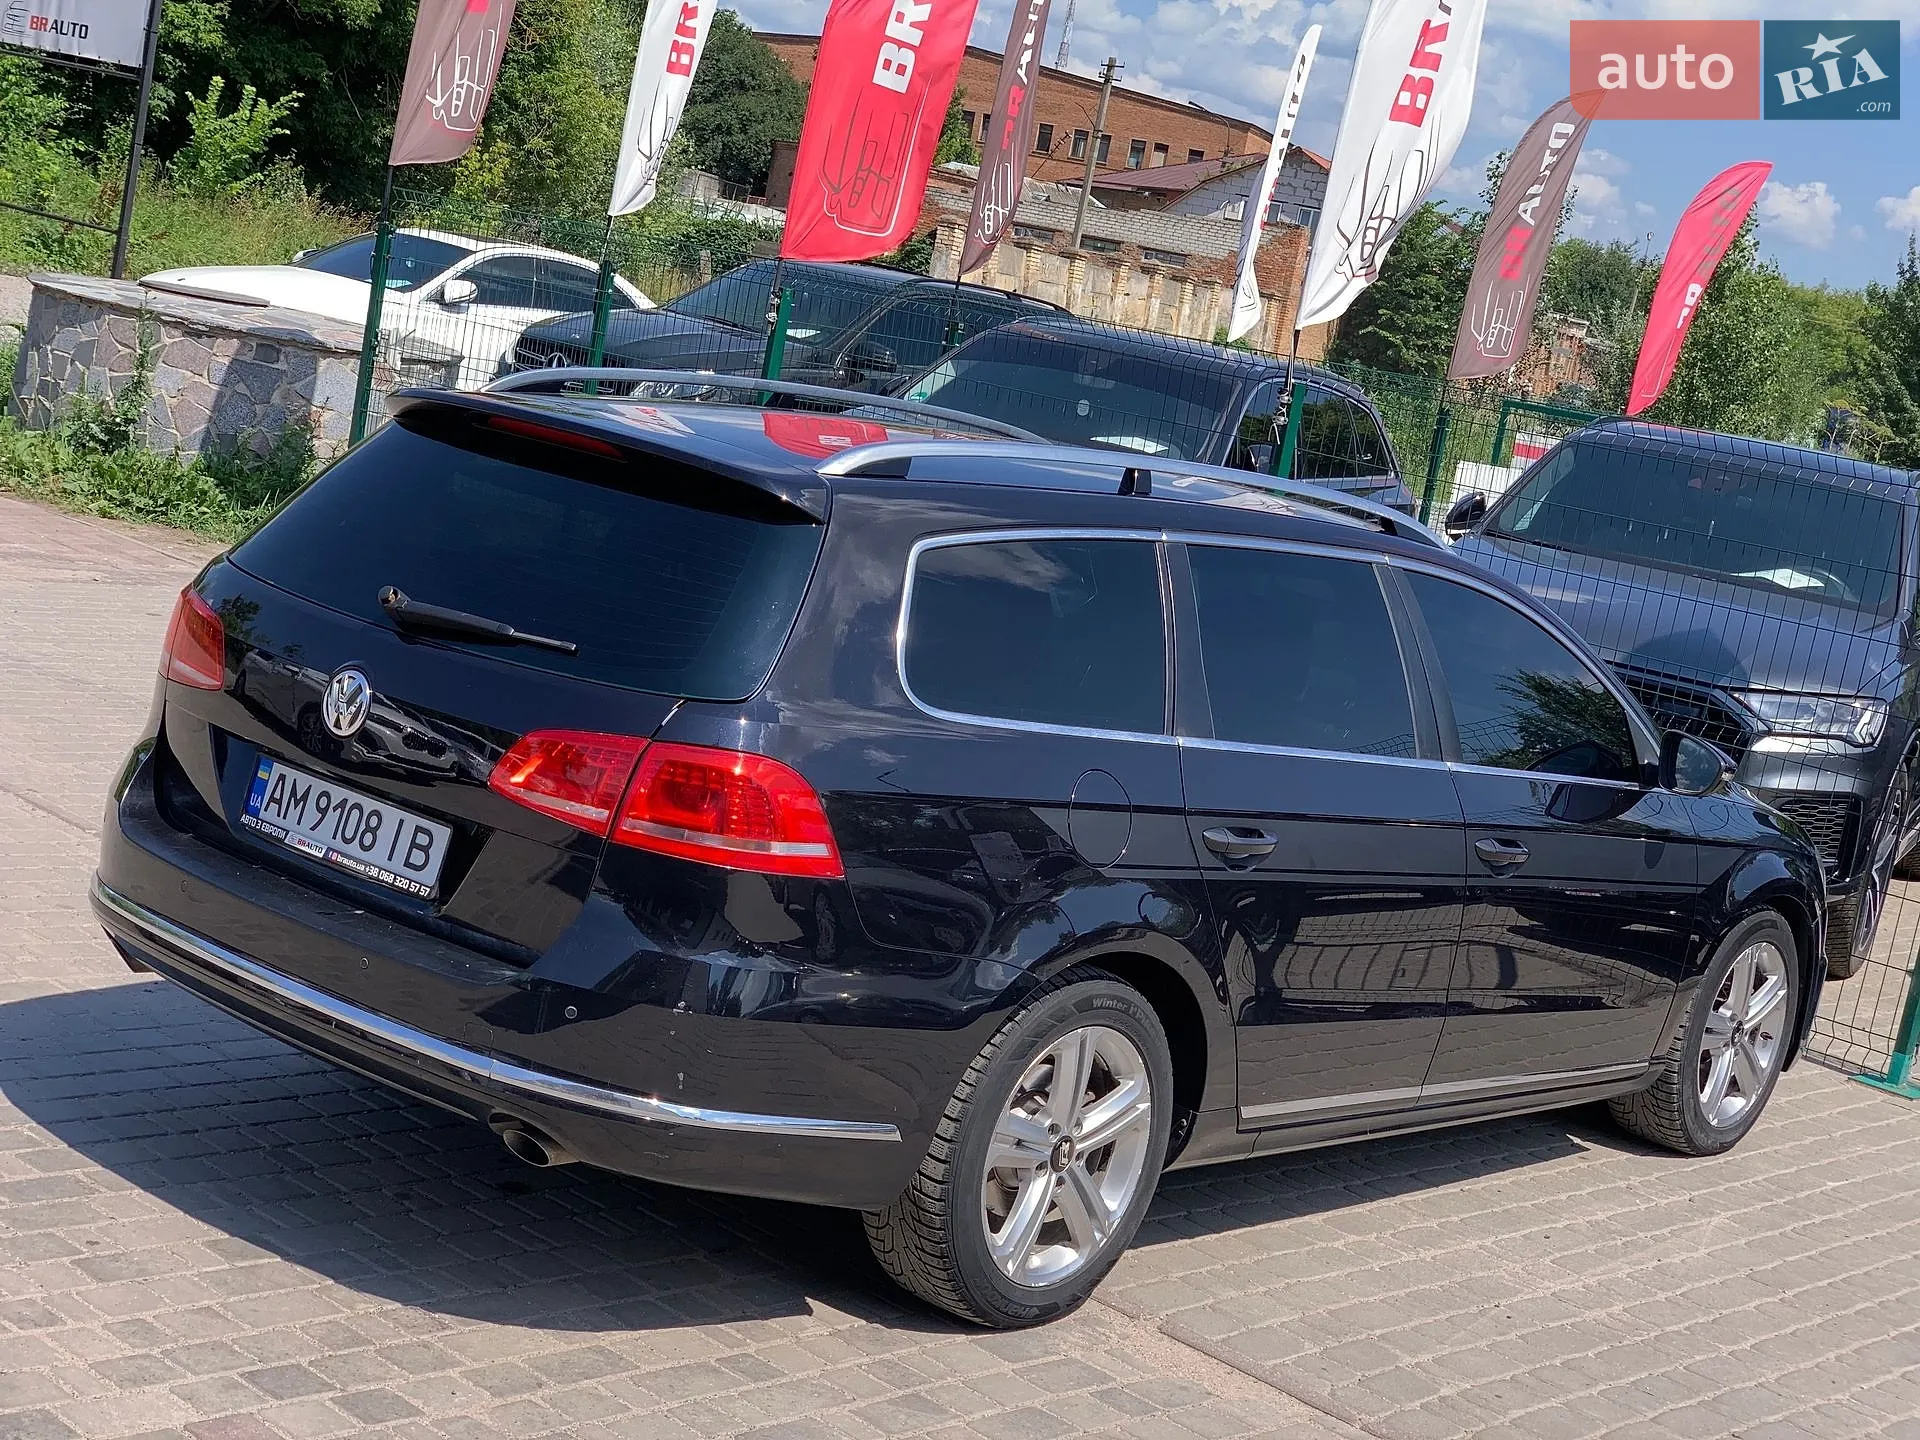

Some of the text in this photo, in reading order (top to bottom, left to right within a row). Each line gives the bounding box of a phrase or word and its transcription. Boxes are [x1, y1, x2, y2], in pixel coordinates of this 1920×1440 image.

[29, 15, 89, 40] BRAUTO
[249, 792, 262, 809] UA
[264, 773, 312, 826] AM
[309, 790, 383, 852] 9108
[297, 838, 322, 854] BRAUTO
[365, 865, 379, 878] +38
[379, 870, 395, 884] 068
[394, 876, 409, 890] 320
[409, 882, 420, 894] 57
[419, 886, 431, 897] 57
[1092, 998, 1127, 1011] Winter
